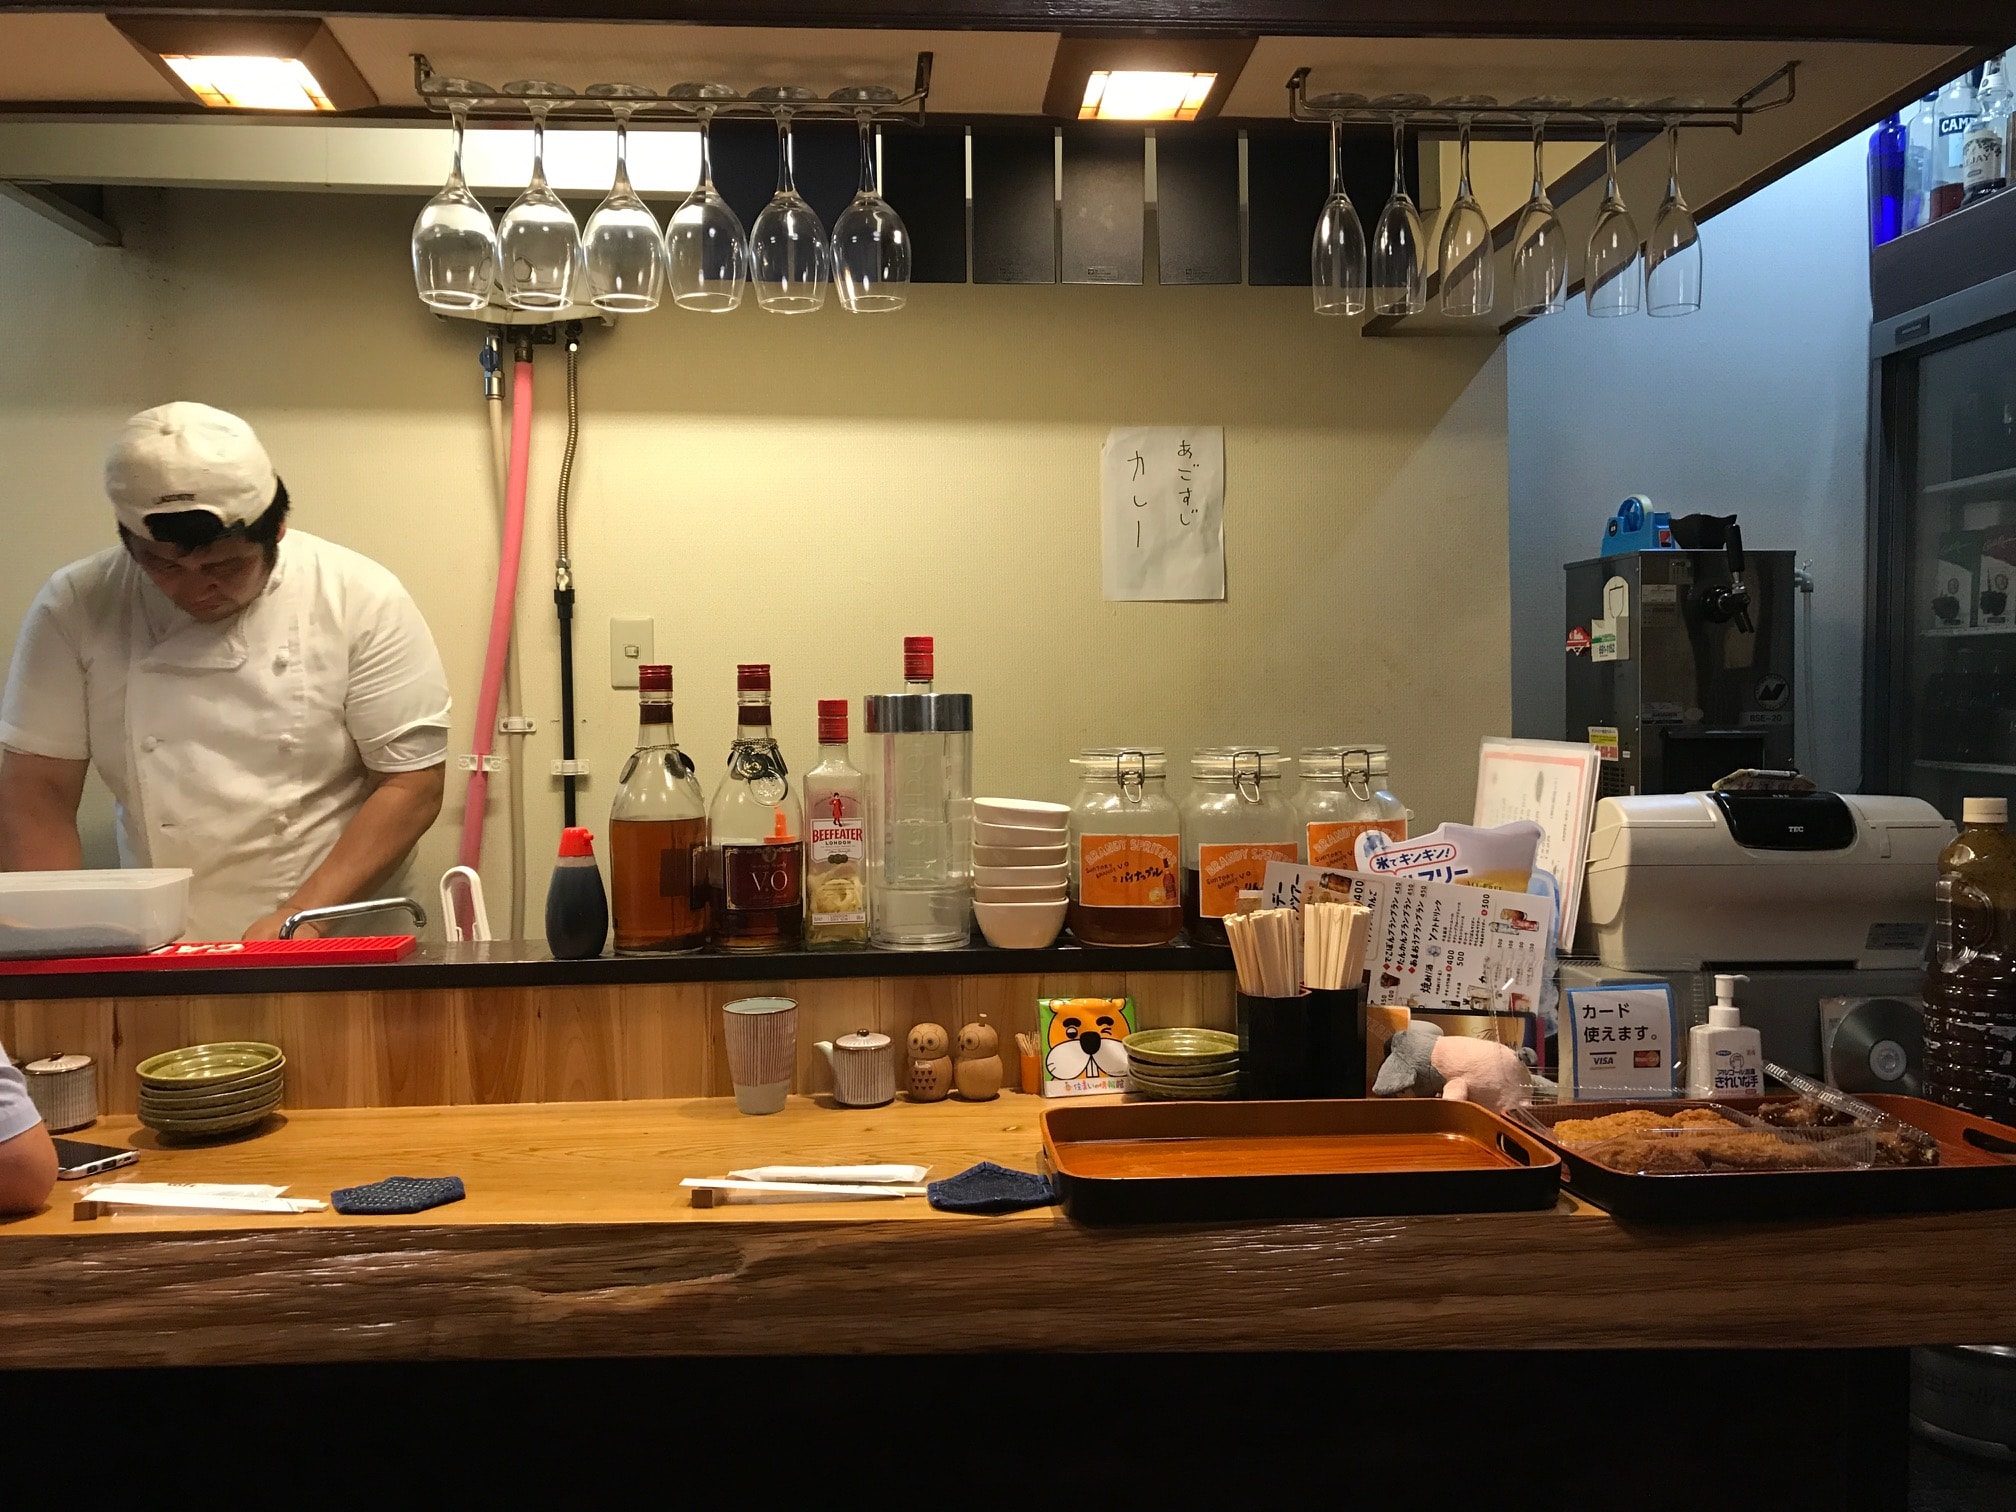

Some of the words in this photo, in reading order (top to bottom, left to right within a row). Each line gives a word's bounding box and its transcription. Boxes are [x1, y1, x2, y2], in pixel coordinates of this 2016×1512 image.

[812, 828, 863, 843] BEEFEATER
[1354, 880, 1364, 901] 400
[1482, 893, 1490, 909] 300
[1428, 900, 1442, 941] ソフトドリンク
[1447, 949, 1455, 966] 400
[1456, 951, 1465, 967] 500
[1582, 1003, 1630, 1019] カード
[1584, 1026, 1658, 1043] 使えます。
[1593, 1056, 1614, 1065] VISA
[1714, 1075, 1759, 1089] きれいな手
